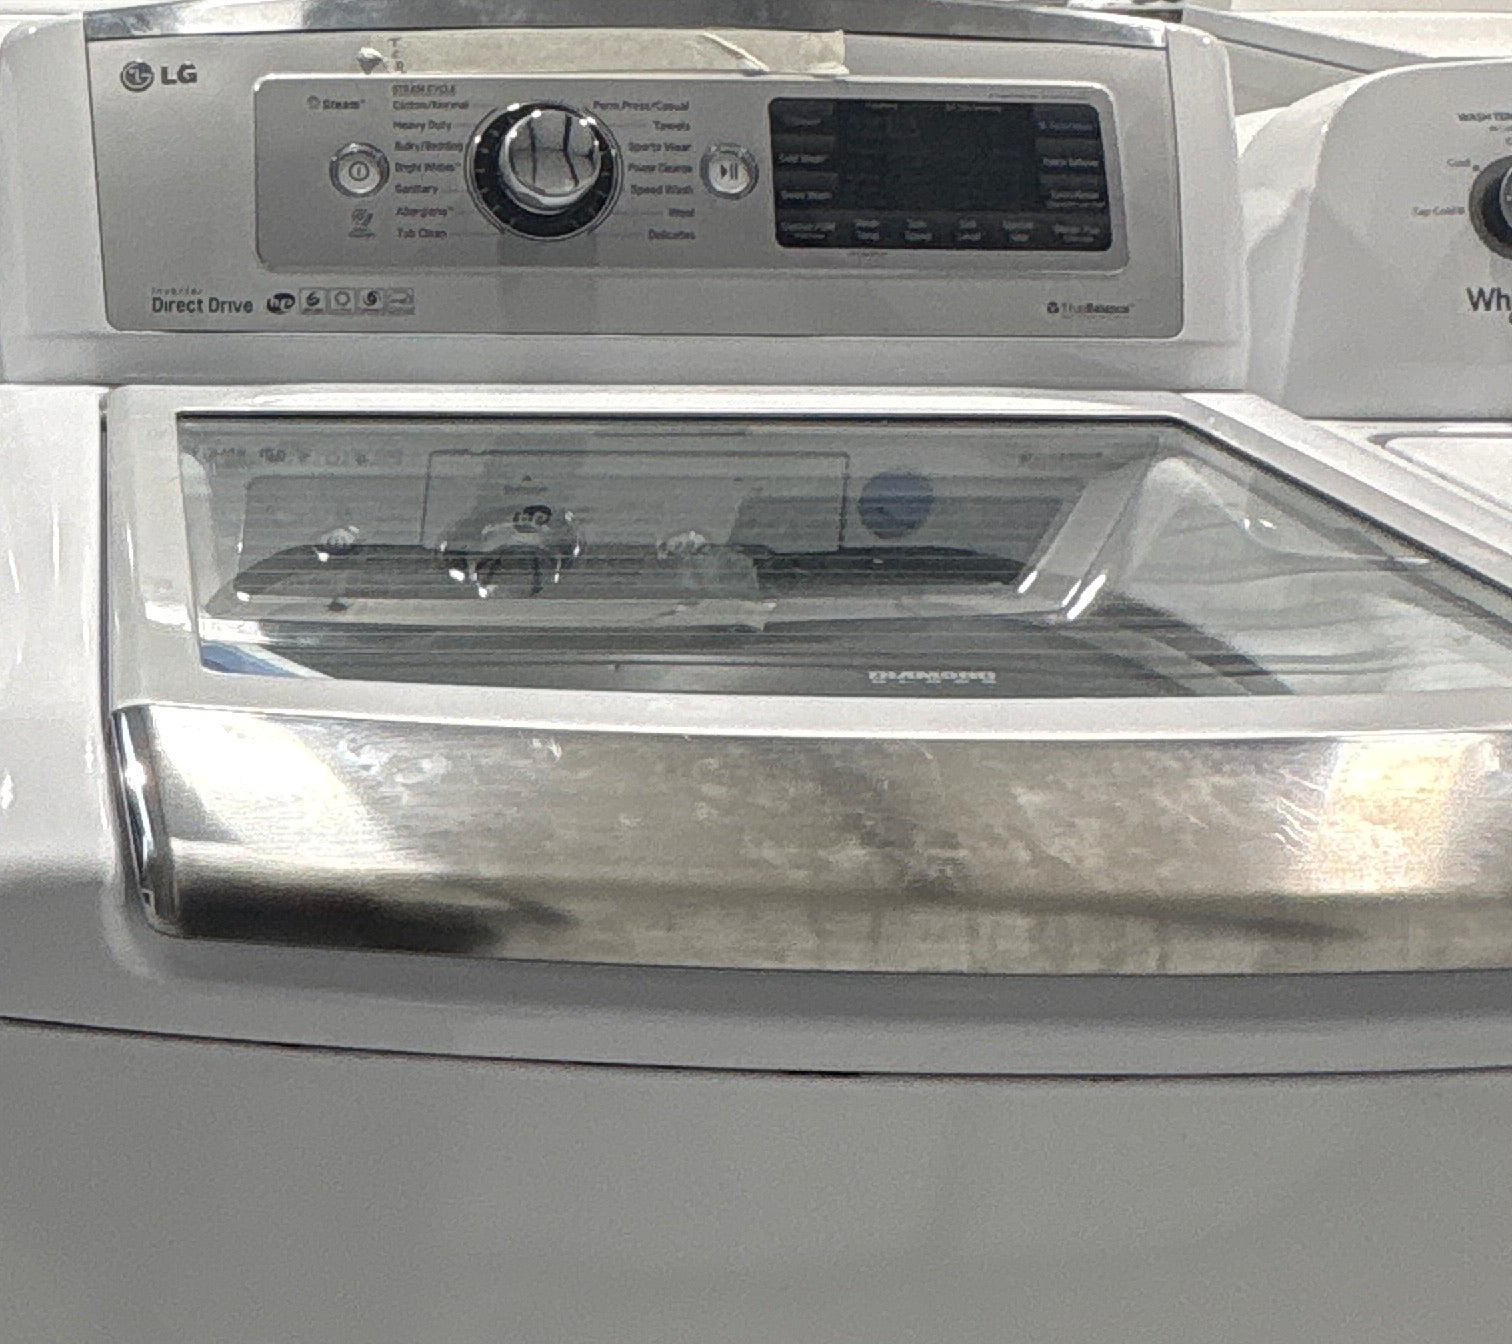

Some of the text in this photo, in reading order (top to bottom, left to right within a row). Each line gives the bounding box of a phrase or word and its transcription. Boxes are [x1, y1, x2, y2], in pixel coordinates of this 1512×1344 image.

[161, 64, 198, 85] LG
[152, 296, 254, 314] Direct Drive
